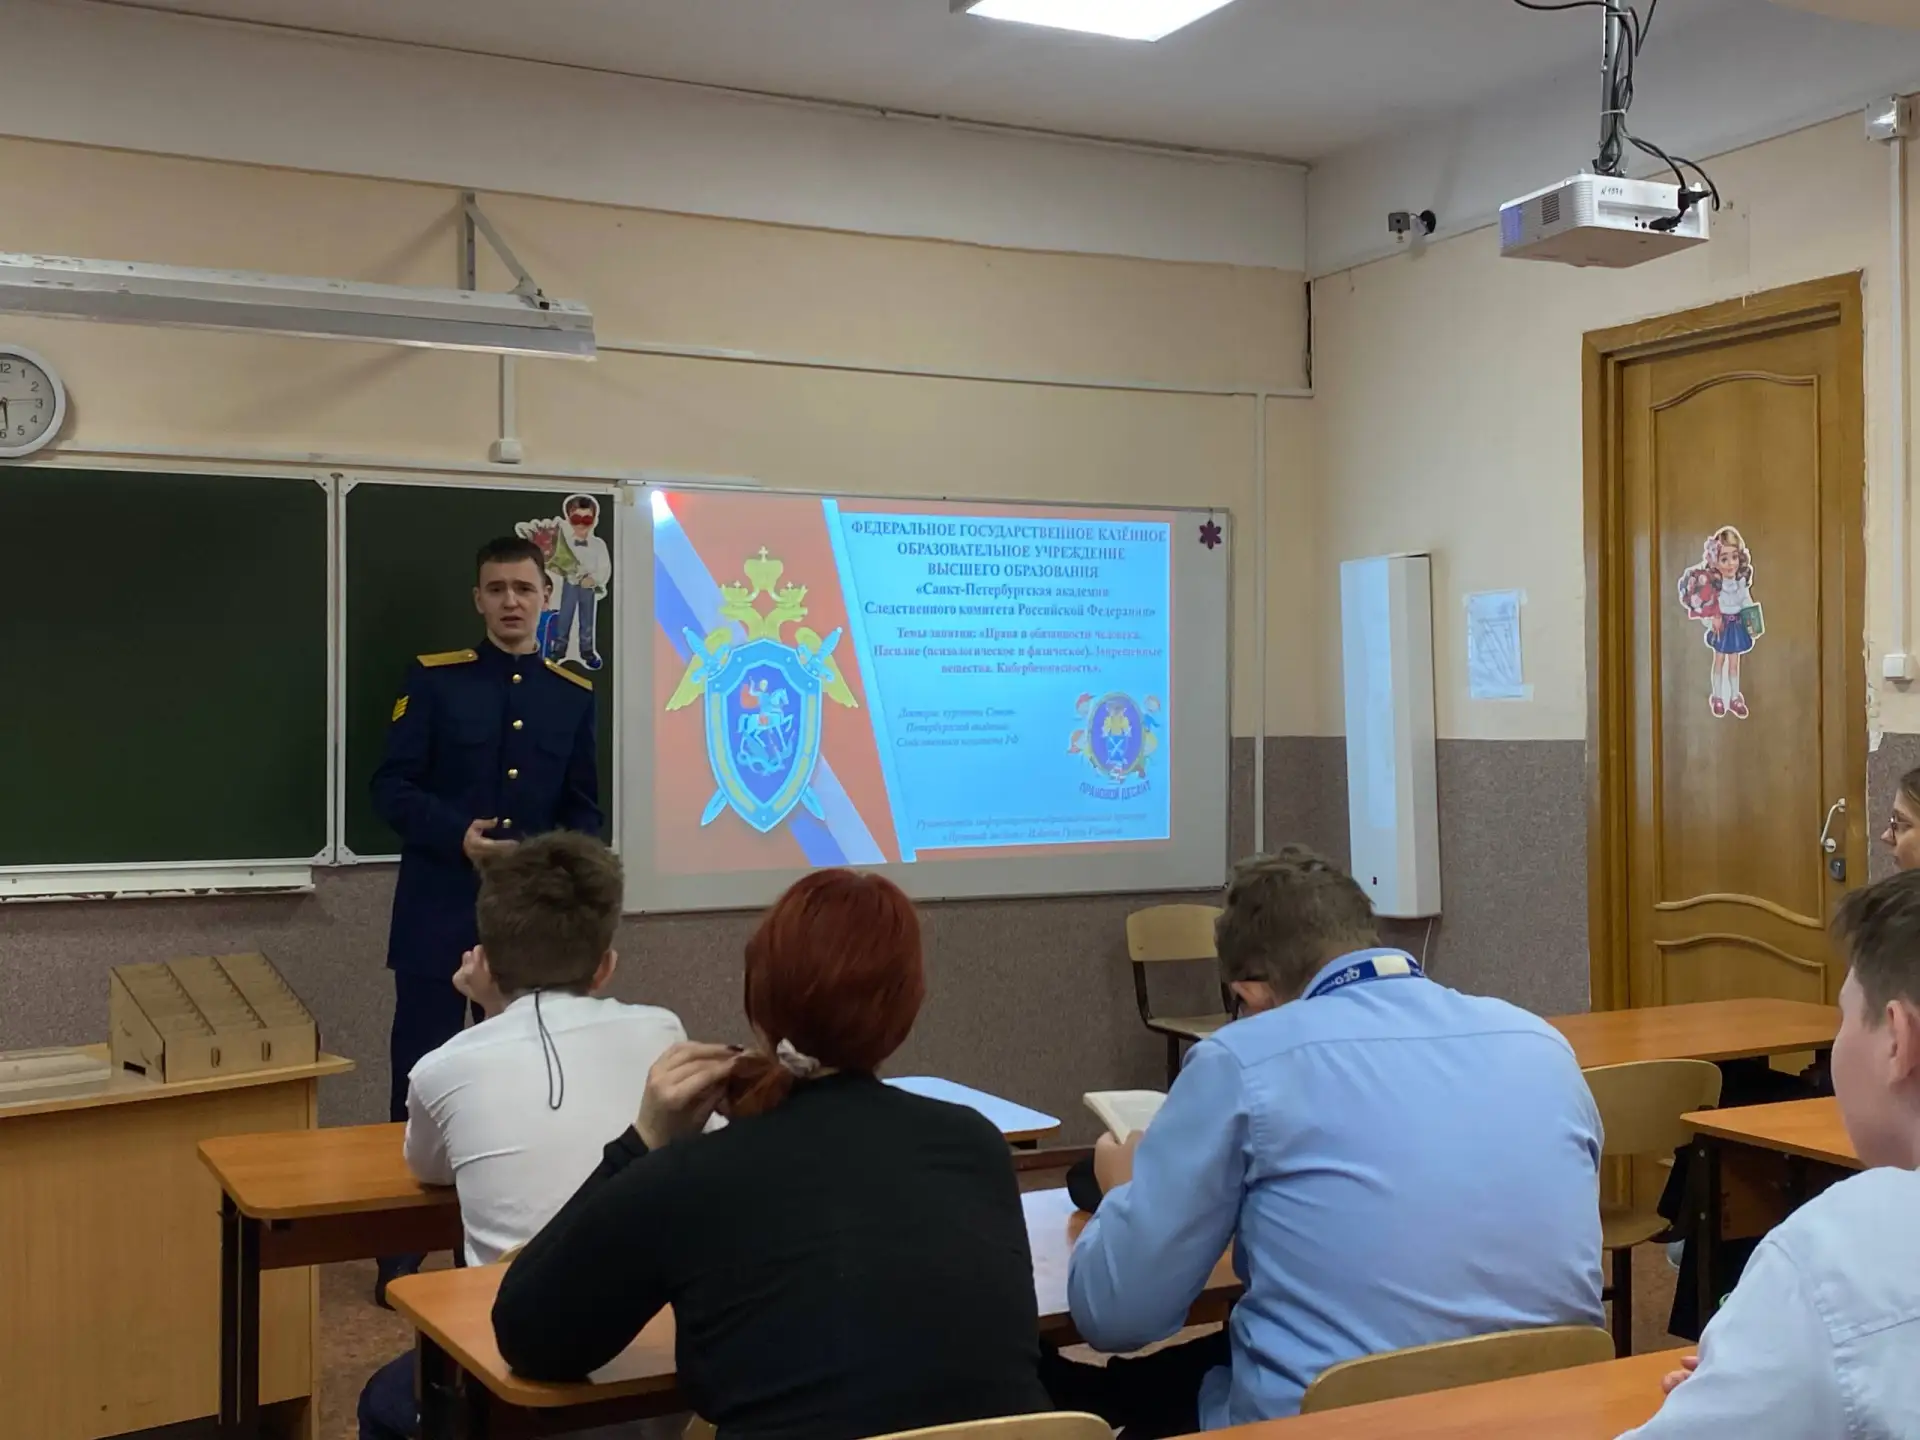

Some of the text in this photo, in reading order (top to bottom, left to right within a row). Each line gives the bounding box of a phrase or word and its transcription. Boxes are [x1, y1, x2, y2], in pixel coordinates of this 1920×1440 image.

[20, 369, 26, 378] 1
[30, 381, 40, 392] 2
[35, 398, 44, 409] 3
[29, 415, 38, 424] 4
[17, 425, 25, 436] 5
[851, 520, 1167, 542] ФЕДЕРАЛЬНОЕ ГОСУДАРСТВЕННОЕ КАЗЁННОЕ
[897, 541, 1126, 561] ОБРАЗОВАТЕЛЬНОЕ УЧРЕЖДЕНИЕ
[927, 562, 1100, 579] ВЫСШЕГО ОБРАЗОВАНИЯ
[916, 582, 1110, 600] «Санкт-Петербургская академии
[864, 601, 1156, 620] Следственного комитета Российской Федерации»
